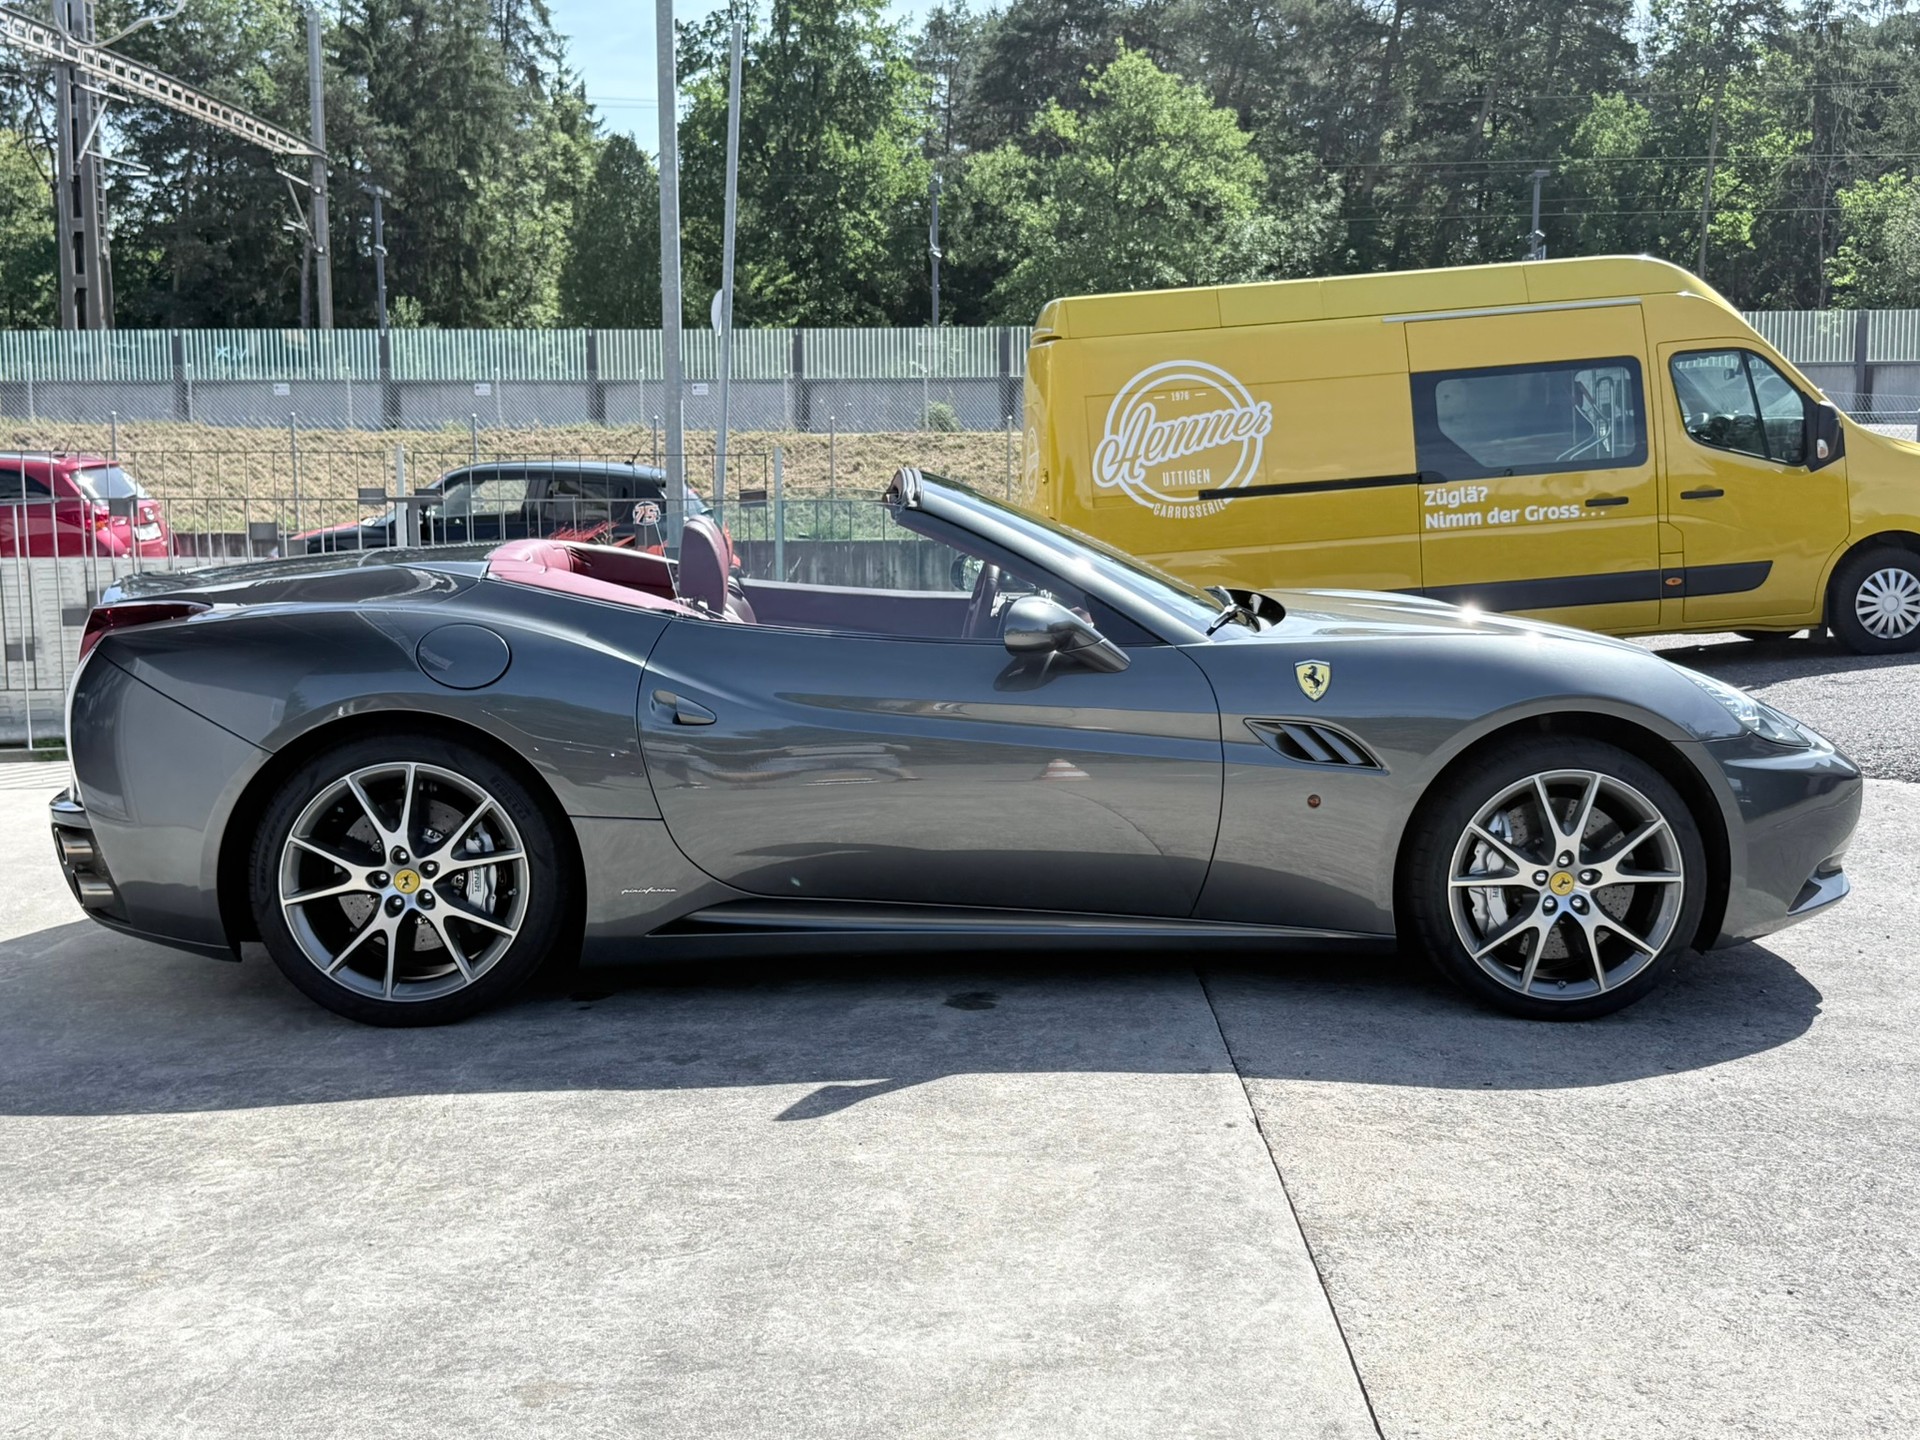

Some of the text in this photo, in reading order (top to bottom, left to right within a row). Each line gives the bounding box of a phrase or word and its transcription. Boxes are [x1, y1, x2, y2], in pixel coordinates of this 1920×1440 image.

[1162, 468, 1211, 487] UTTIGEN
[1424, 487, 1488, 507] Züglä?
[1153, 499, 1226, 518] CARROSSERIE
[1425, 512, 1482, 529] Nimm
[1487, 507, 1520, 524] der
